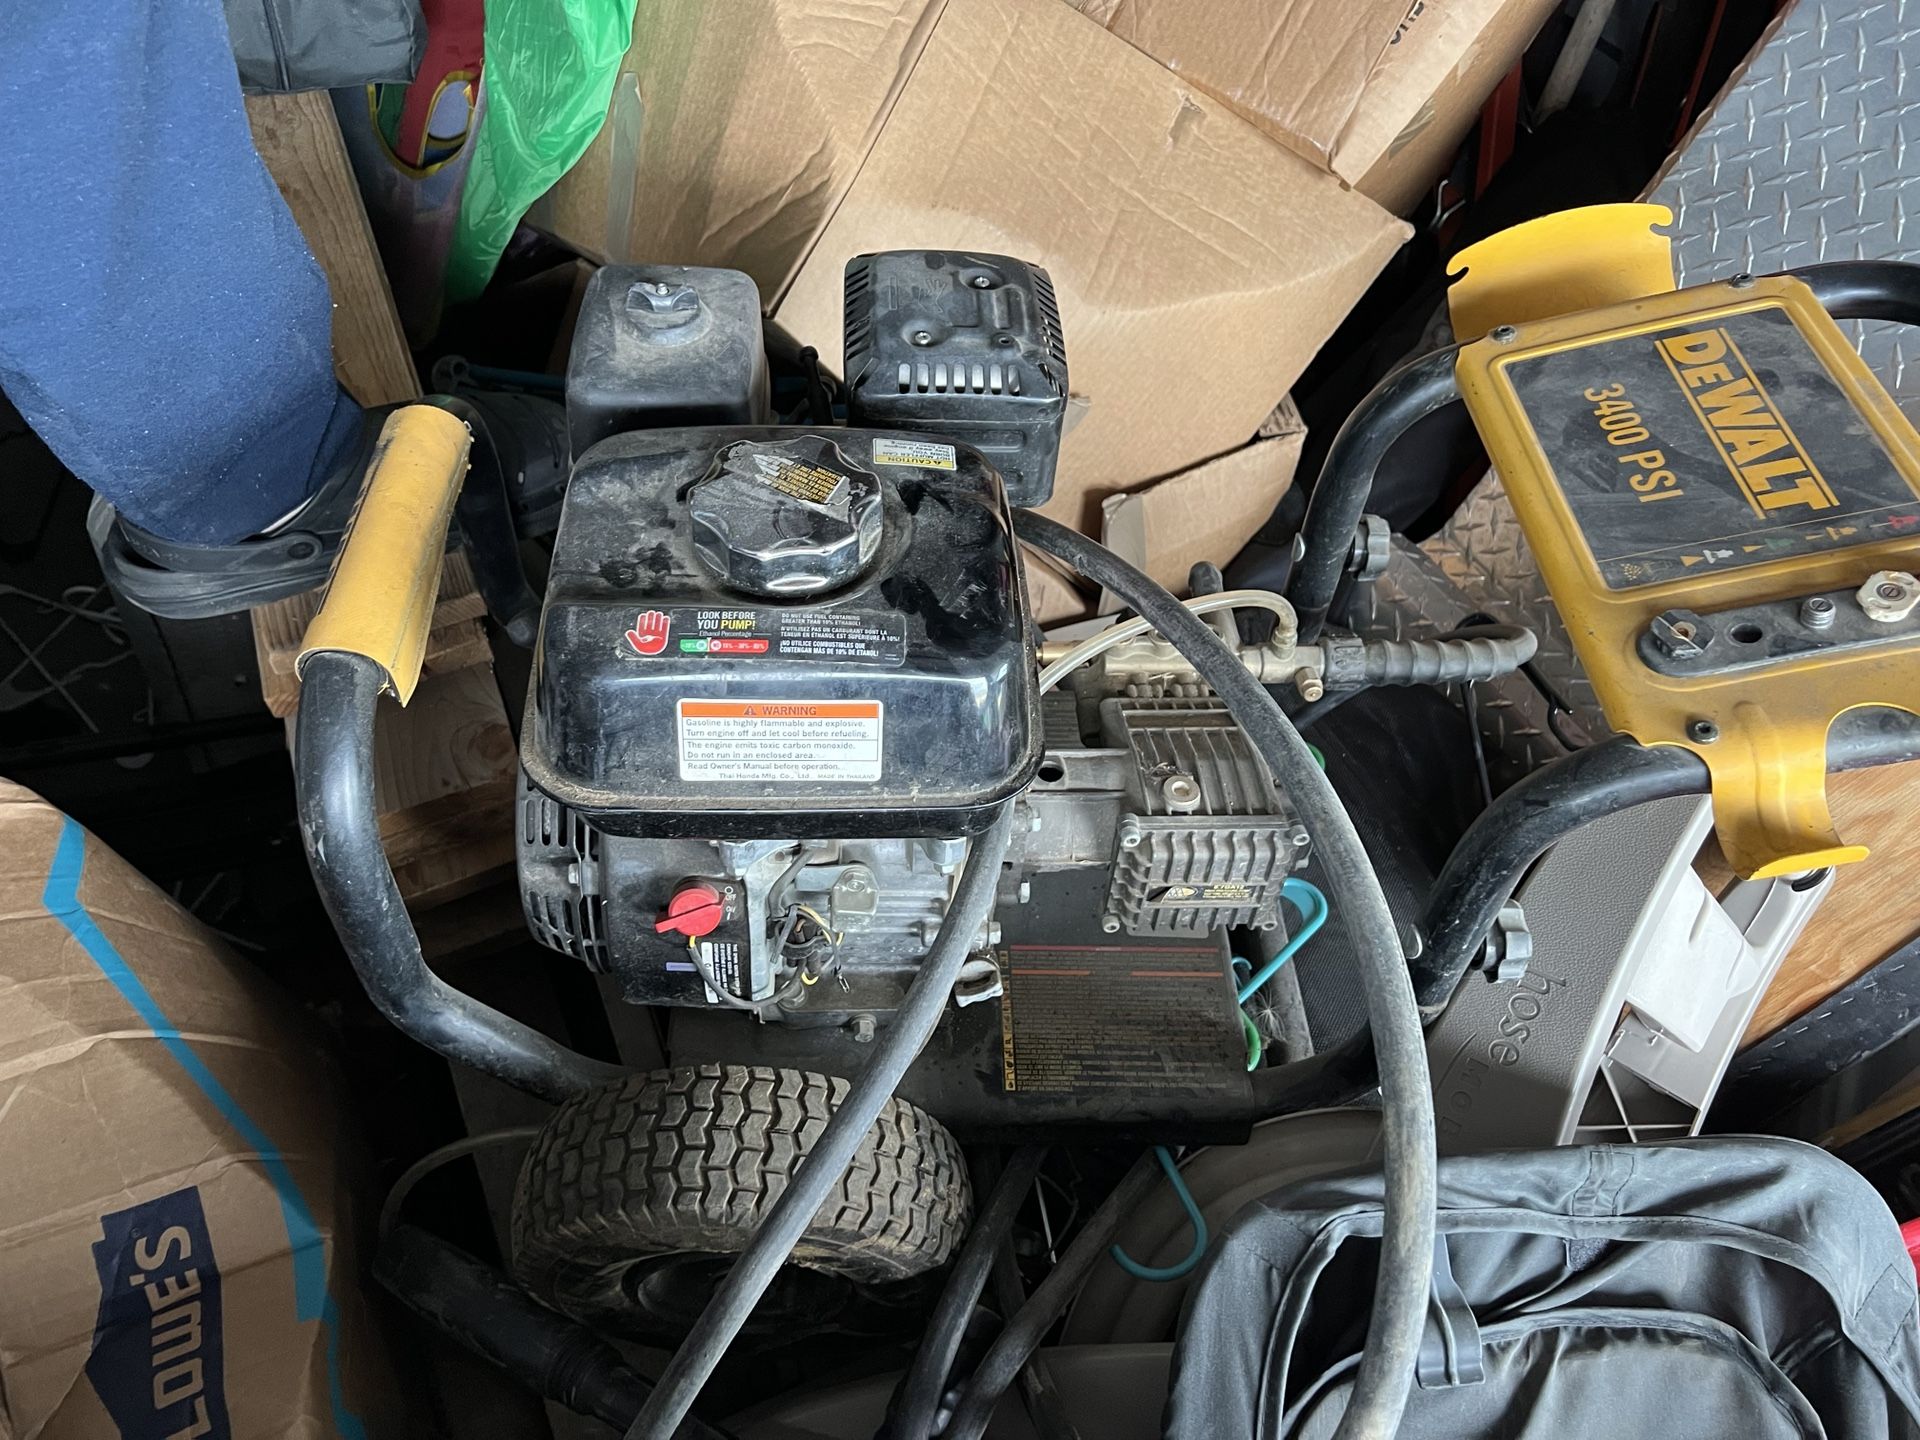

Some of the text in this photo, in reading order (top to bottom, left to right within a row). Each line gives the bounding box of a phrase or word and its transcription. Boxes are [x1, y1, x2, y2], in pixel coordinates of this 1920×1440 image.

[1662, 329, 1831, 510] DEWALT
[1584, 383, 1684, 503] 3400 PSI
[697, 611, 756, 620] LOOK BEFORE
[698, 620, 756, 630] YOU PUMP!
[762, 706, 817, 716] WARNING
[686, 719, 866, 730] Gasoline is highly flammable and explosive.
[686, 729, 705, 737] Turn
[707, 730, 735, 739] engine
[737, 729, 749, 737] off
[802, 730, 829, 738] before
[830, 730, 869, 739] refueling.
[688, 741, 856, 751] The engine emits toxic carbon monoxide.
[687, 751, 699, 759] Do
[755, 752, 793, 760] enclosed
[688, 762, 708, 770] Read
[710, 762, 741, 770] Owner's
[801, 763, 841, 772] operation.
[725, 905, 737, 913] ON
[1488, 970, 1566, 1066] hose
[130, 1225, 213, 1440] LOWE'S
